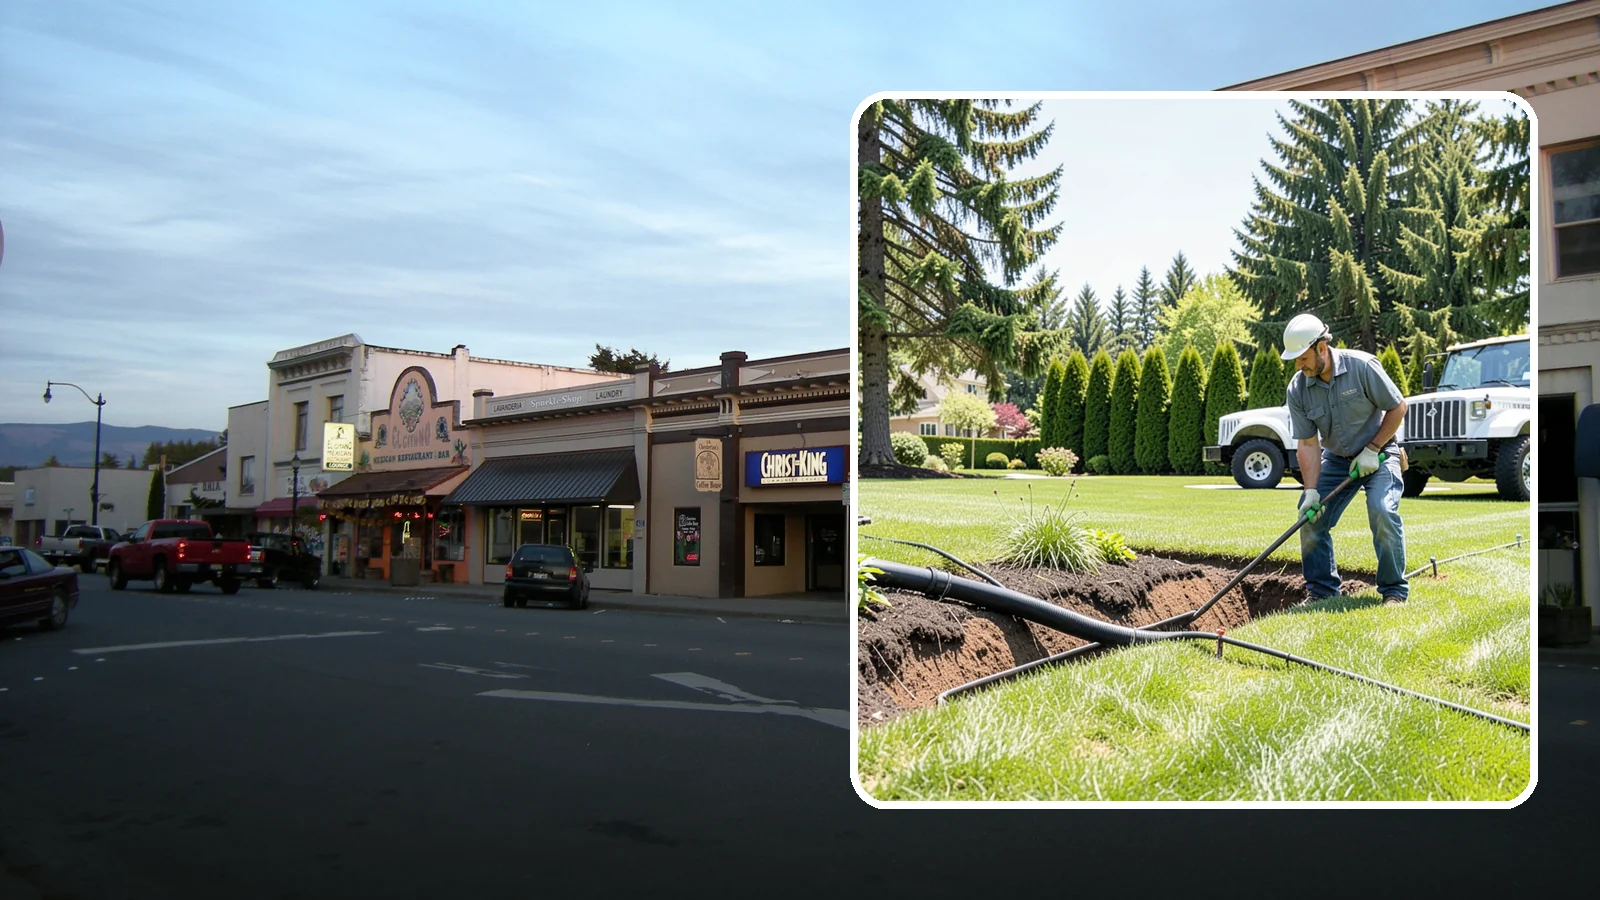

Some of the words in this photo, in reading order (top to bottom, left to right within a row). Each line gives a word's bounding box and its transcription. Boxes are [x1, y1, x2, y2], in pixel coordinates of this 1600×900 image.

[595, 389, 623, 400] LAUNDRY
[493, 402, 522, 413] LAVANDERIA
[374, 455, 396, 464] MEXICAN
[397, 451, 433, 462] RESTAURANT
[437, 450, 450, 459] BAR
[761, 452, 797, 478] CHRIST
[799, 450, 827, 476] KING
